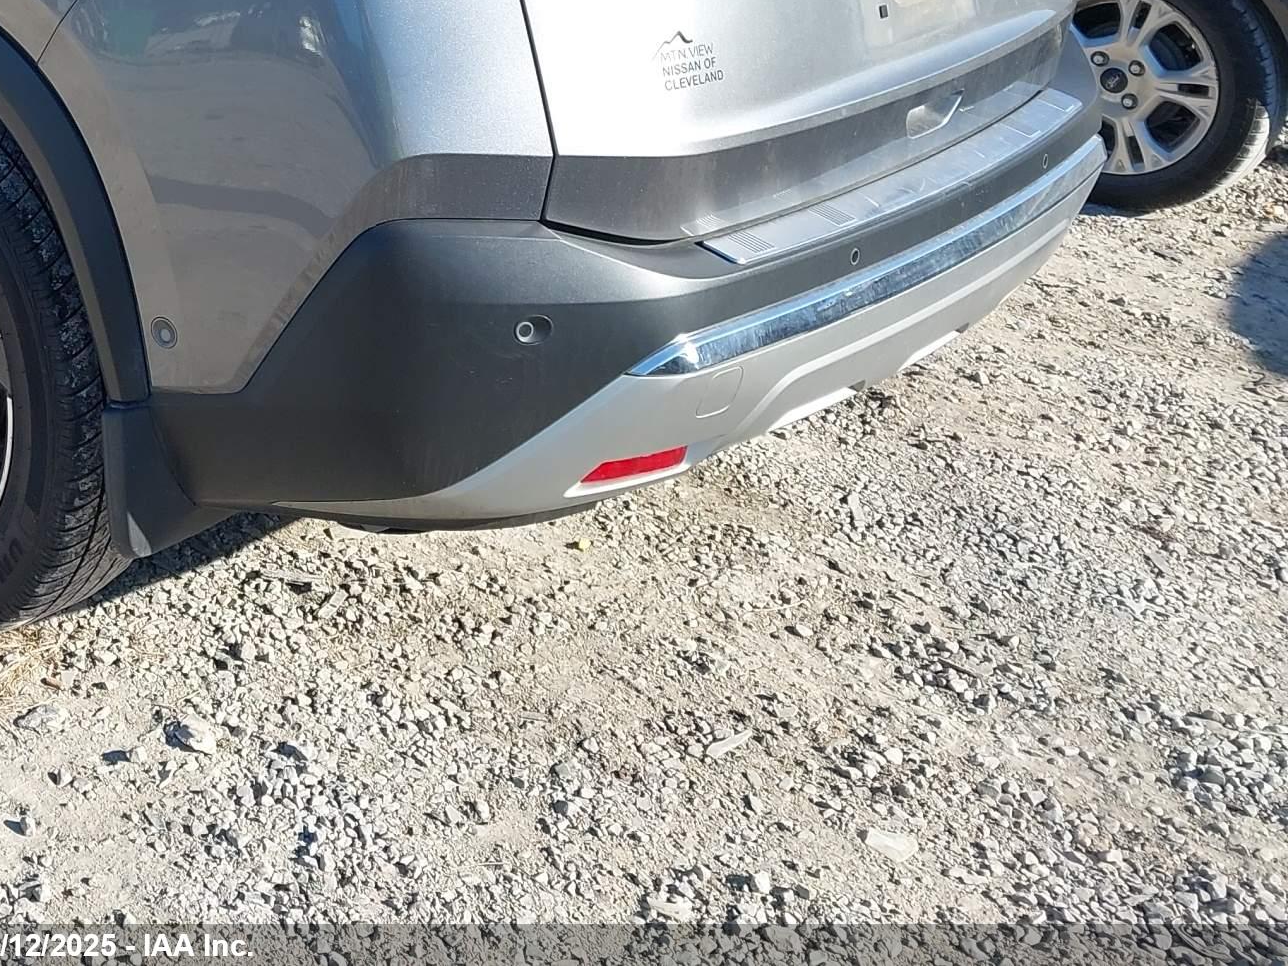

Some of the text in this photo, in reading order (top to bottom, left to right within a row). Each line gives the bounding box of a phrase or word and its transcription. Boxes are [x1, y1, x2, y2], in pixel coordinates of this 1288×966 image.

[688, 42, 713, 57] VIEW
[662, 56, 716, 77] NISSAN OF
[664, 69, 724, 91] CLEVELAND
